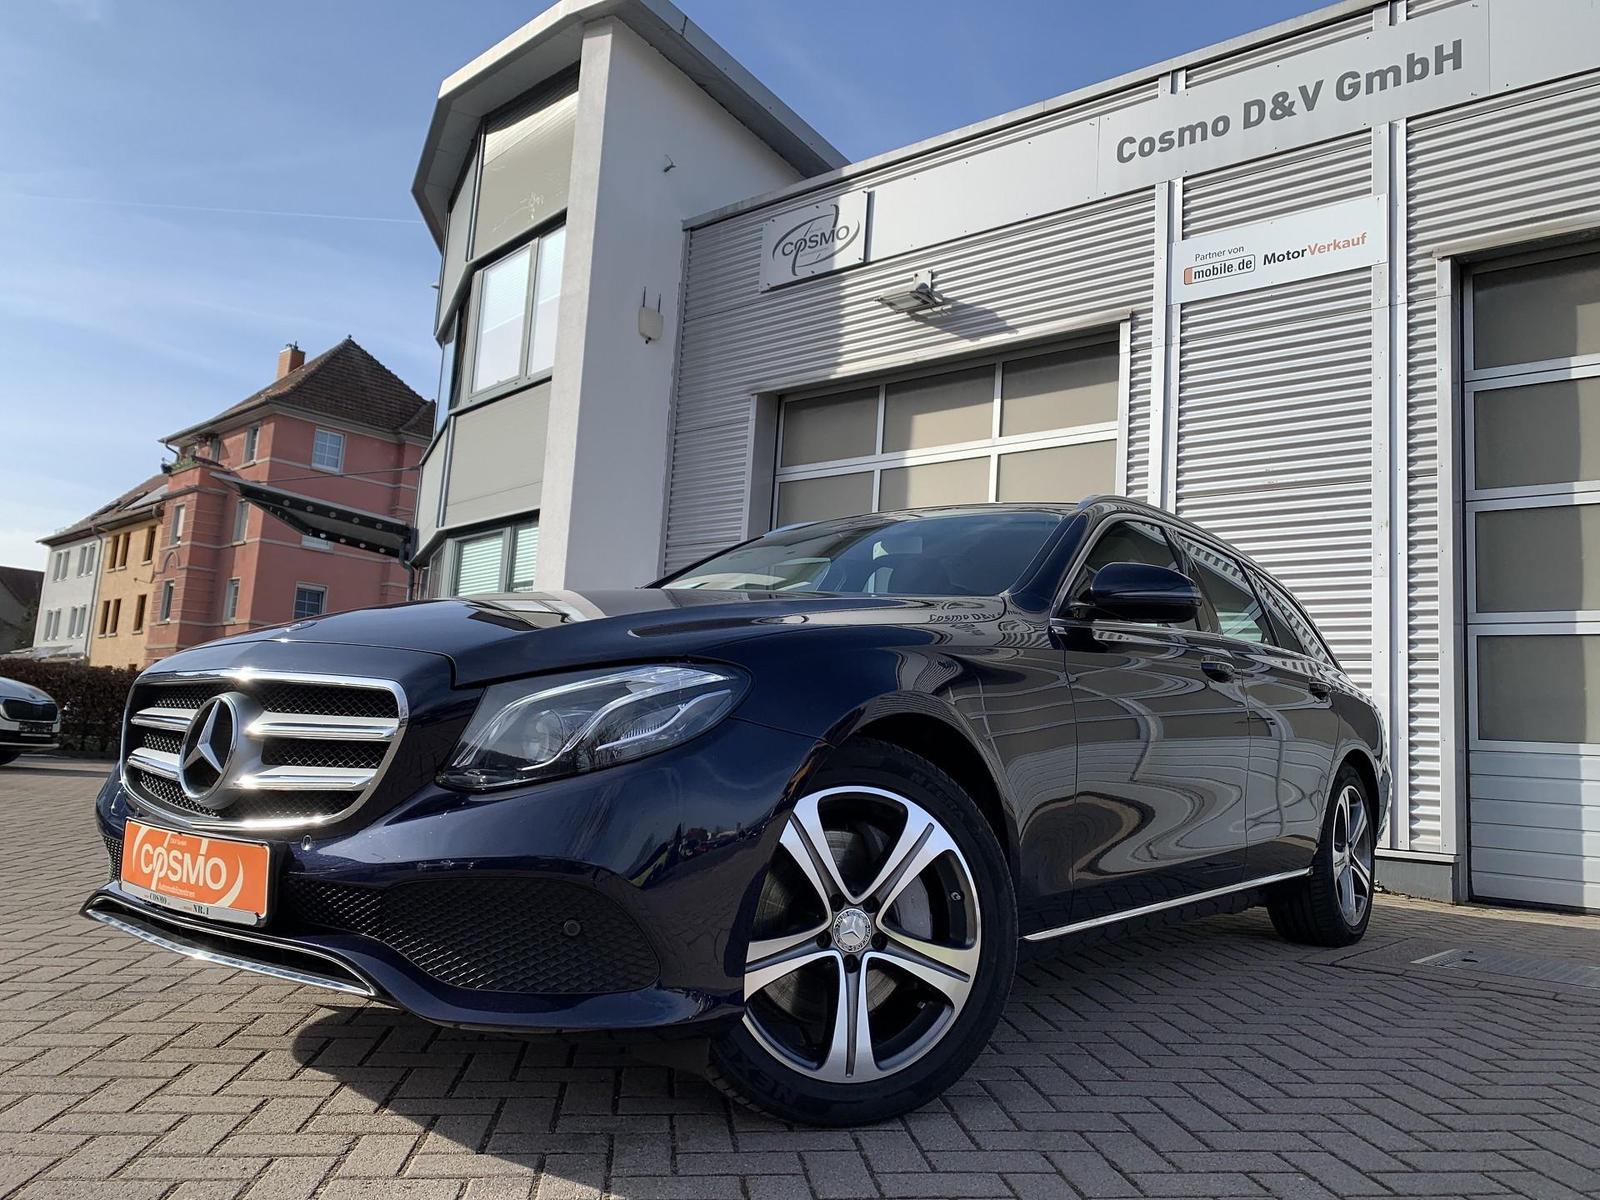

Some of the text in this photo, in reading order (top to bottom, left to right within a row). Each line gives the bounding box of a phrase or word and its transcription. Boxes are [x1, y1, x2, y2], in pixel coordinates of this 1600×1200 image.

[1116, 38, 1463, 164] Cosmo D&V GmbH
[781, 225, 850, 258] COSMO
[1194, 245, 1245, 262] Partner von
[1262, 231, 1368, 266] MotorVerkauf
[1192, 257, 1253, 281] mobile.de
[140, 842, 228, 891] COSMO
